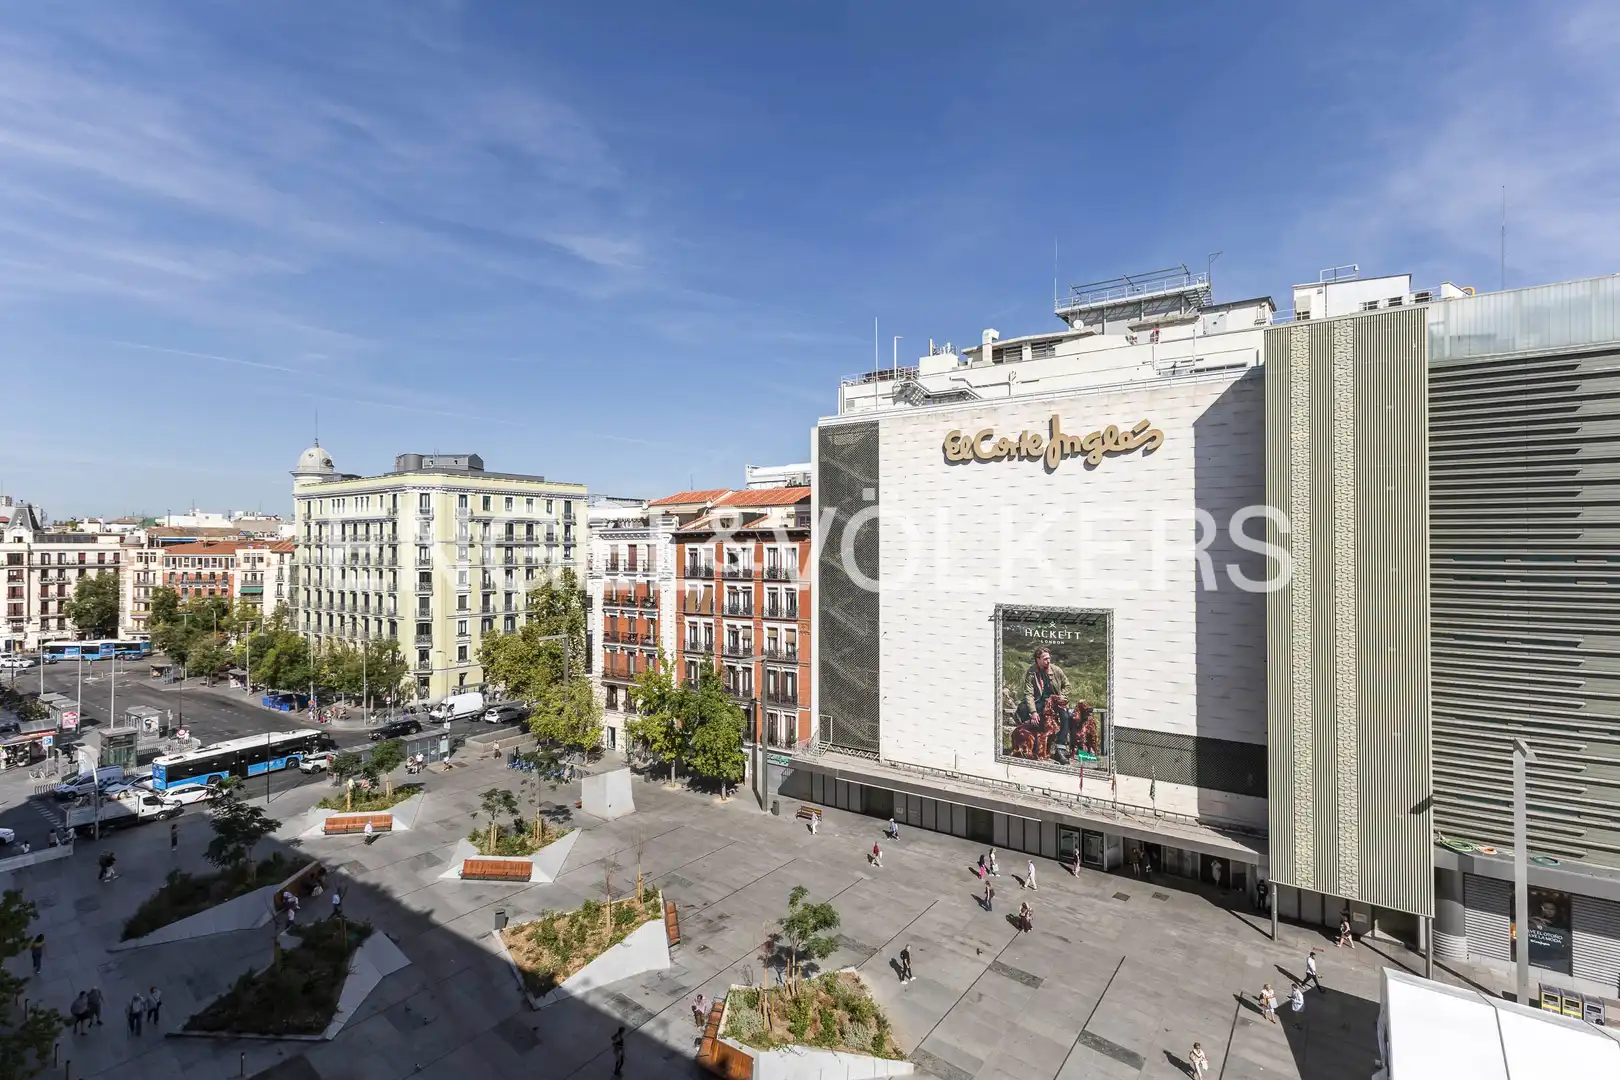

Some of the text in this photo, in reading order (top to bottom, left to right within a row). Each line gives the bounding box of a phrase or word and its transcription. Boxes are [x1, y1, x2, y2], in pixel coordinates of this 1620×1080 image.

[943, 414, 1165, 470] El Corte Inglés
[1024, 627, 1081, 640] HACKETT
